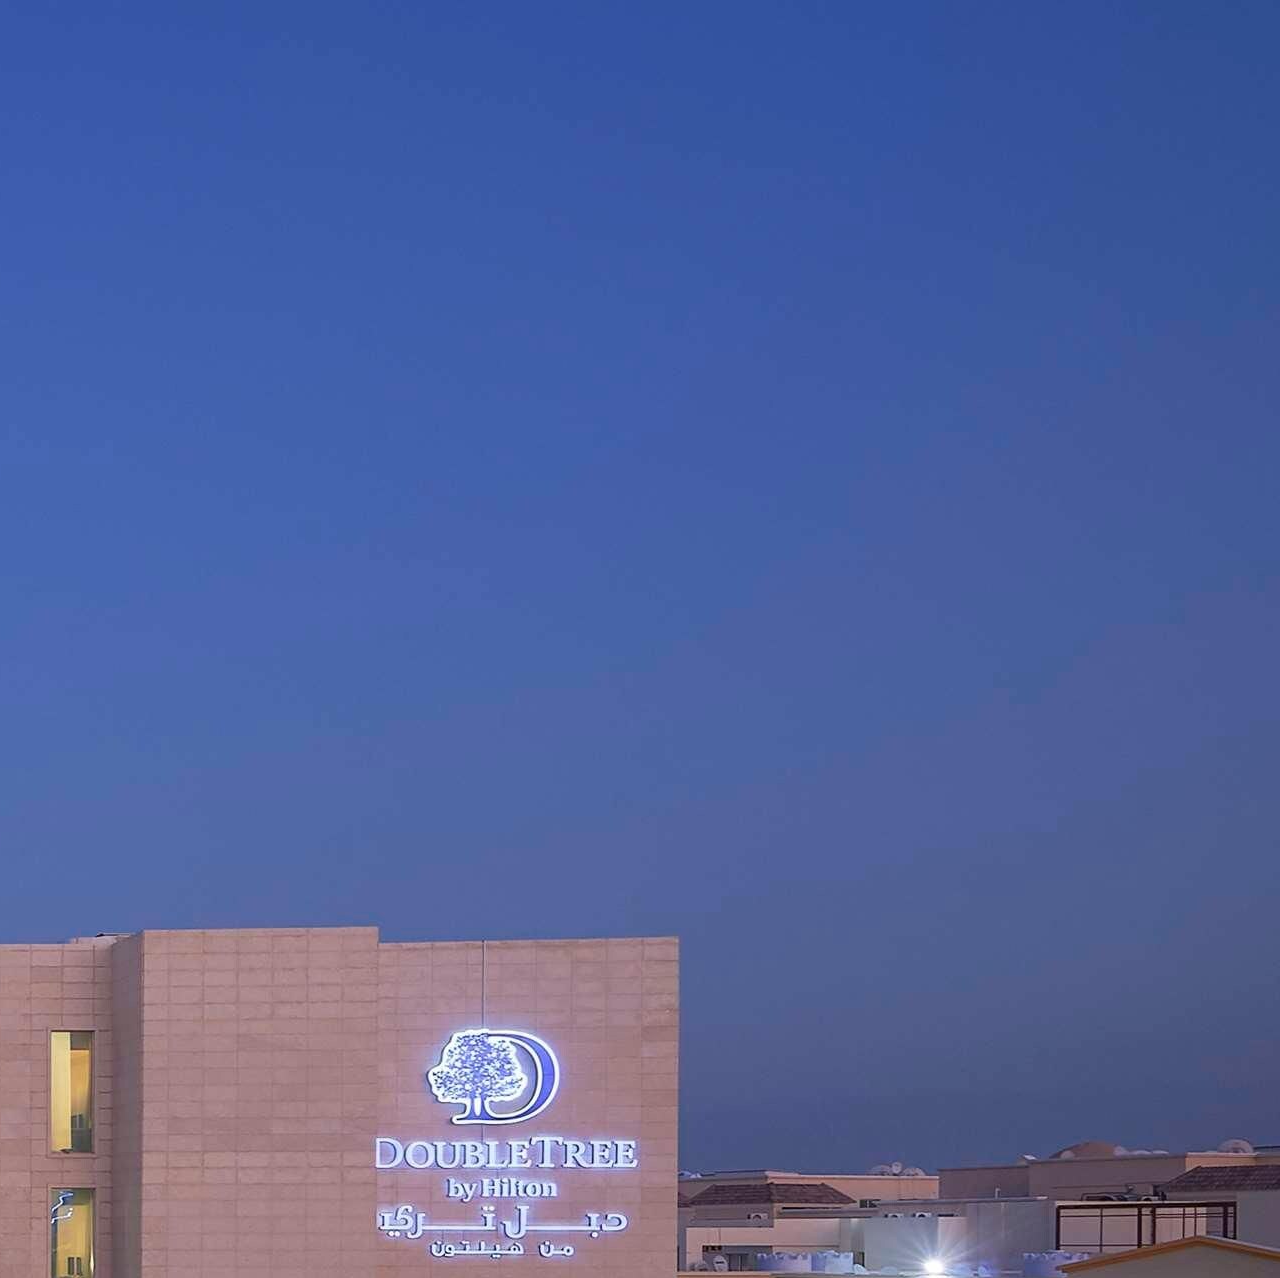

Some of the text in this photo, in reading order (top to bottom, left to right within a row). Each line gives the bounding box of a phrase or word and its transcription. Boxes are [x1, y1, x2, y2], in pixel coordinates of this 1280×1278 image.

[375, 1136, 638, 1169] DOUBLETREE
[448, 1178, 558, 1201] by Hilton
[430, 1241, 574, 1258] من هيلتون
